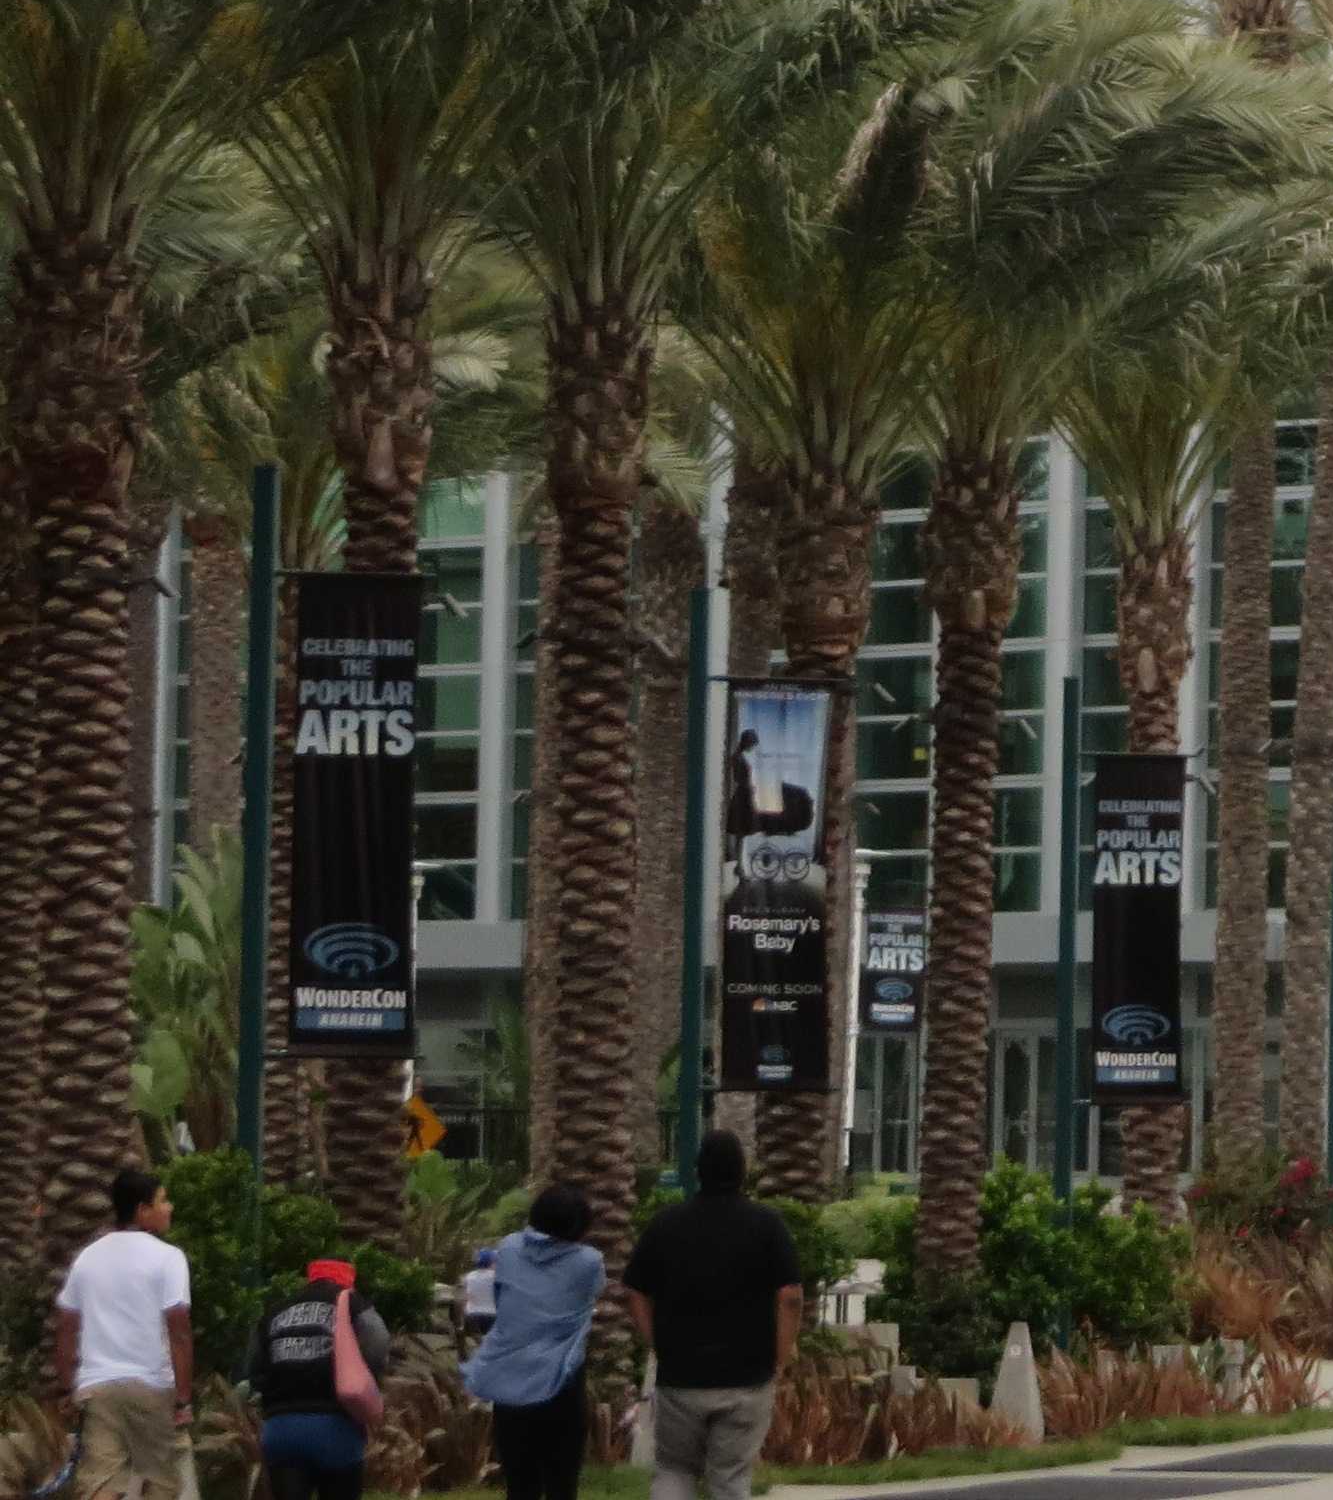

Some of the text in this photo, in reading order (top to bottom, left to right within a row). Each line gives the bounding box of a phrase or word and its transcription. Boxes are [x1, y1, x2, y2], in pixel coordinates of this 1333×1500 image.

[341, 659, 373, 677] THE
[299, 680, 415, 705] POPULAR
[296, 709, 416, 756] ARTS
[1096, 829, 1181, 849] POPULAR
[1094, 851, 1181, 886] ARTS
[729, 914, 821, 935] Rosemary's
[754, 932, 797, 953] Baby
[866, 947, 925, 972] ARTS
